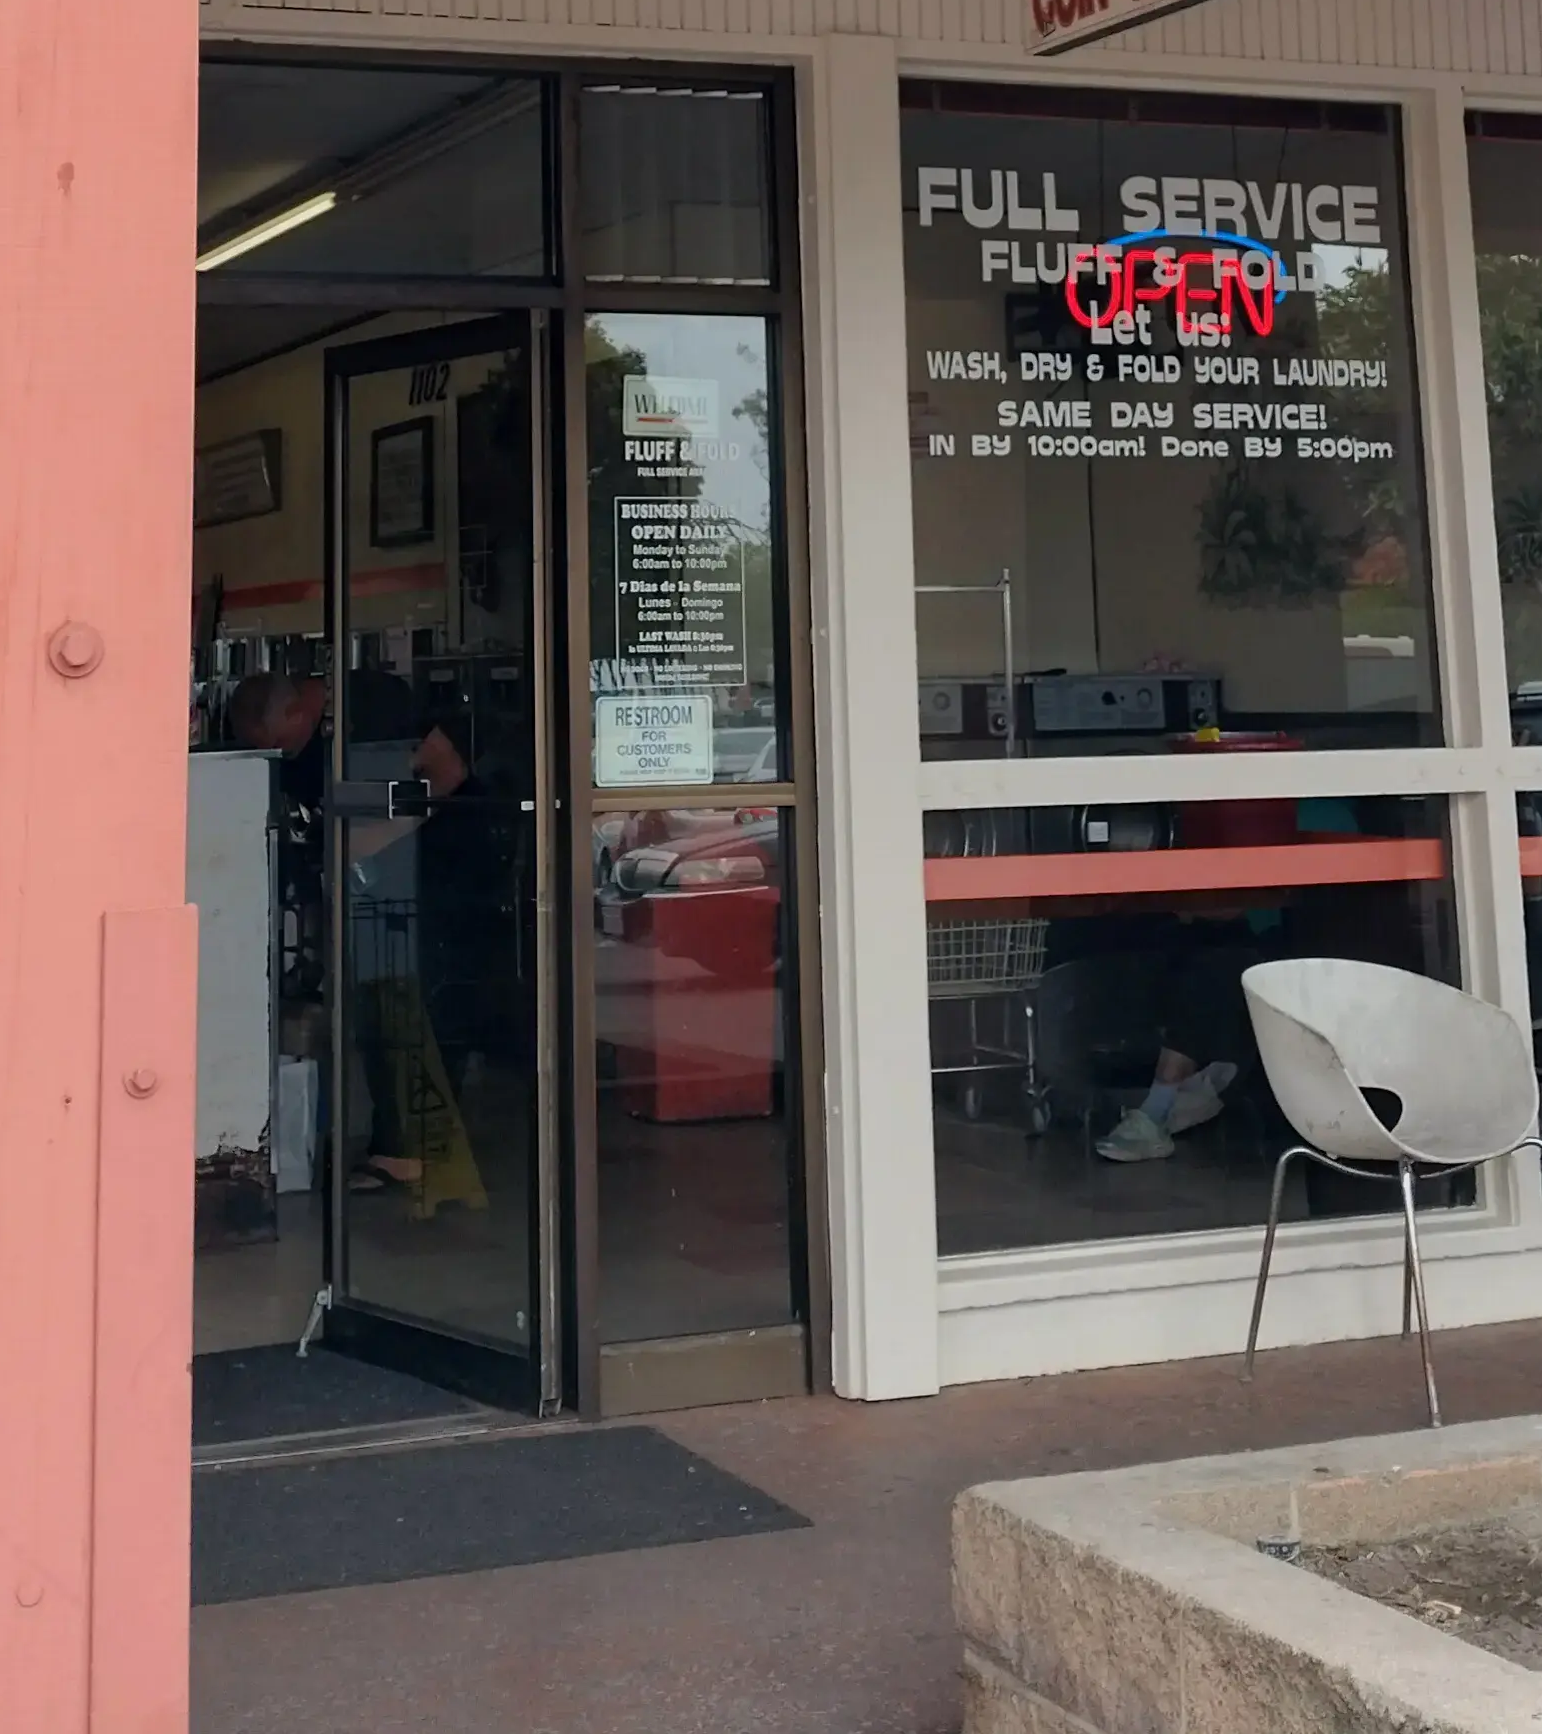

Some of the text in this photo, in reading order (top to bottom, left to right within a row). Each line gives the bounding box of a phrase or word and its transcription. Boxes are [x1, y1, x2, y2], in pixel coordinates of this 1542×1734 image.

[918, 167, 1381, 243] FULL SERVICE
[981, 240, 1325, 291] FLUFF & FOLD
[1065, 249, 1276, 337] OPEN
[1090, 301, 1231, 347] Let us:
[927, 351, 1387, 389] WASH, DRY & FOLD YOUR LAUNDRY!
[409, 363, 451, 405] 1102
[998, 401, 1328, 431] SAME DAY SERVICE!
[625, 440, 740, 462] FLUFF & FOLD
[929, 435, 1393, 462] IN BY 10:00am! Done BY 5:00pm
[621, 504, 735, 519] BUSINESS HOUR
[631, 525, 728, 539] OPEN DAILY
[633, 544, 726, 557] Monday to Sunday
[632, 558, 727, 571] 6:00am to 10:00pm
[619, 580, 741, 594] 7 Dias de la Semana
[639, 597, 671, 608] Lunes
[681, 597, 723, 609] Domingo
[638, 611, 724, 622] 6:00am to 10:00pm
[639, 631, 663, 642] LAST
[664, 631, 691, 641] WASH
[615, 706, 693, 726] RESTROOM
[641, 731, 667, 741] FOR
[617, 743, 692, 756] CUSTOMERS
[638, 757, 670, 768] ONLY
